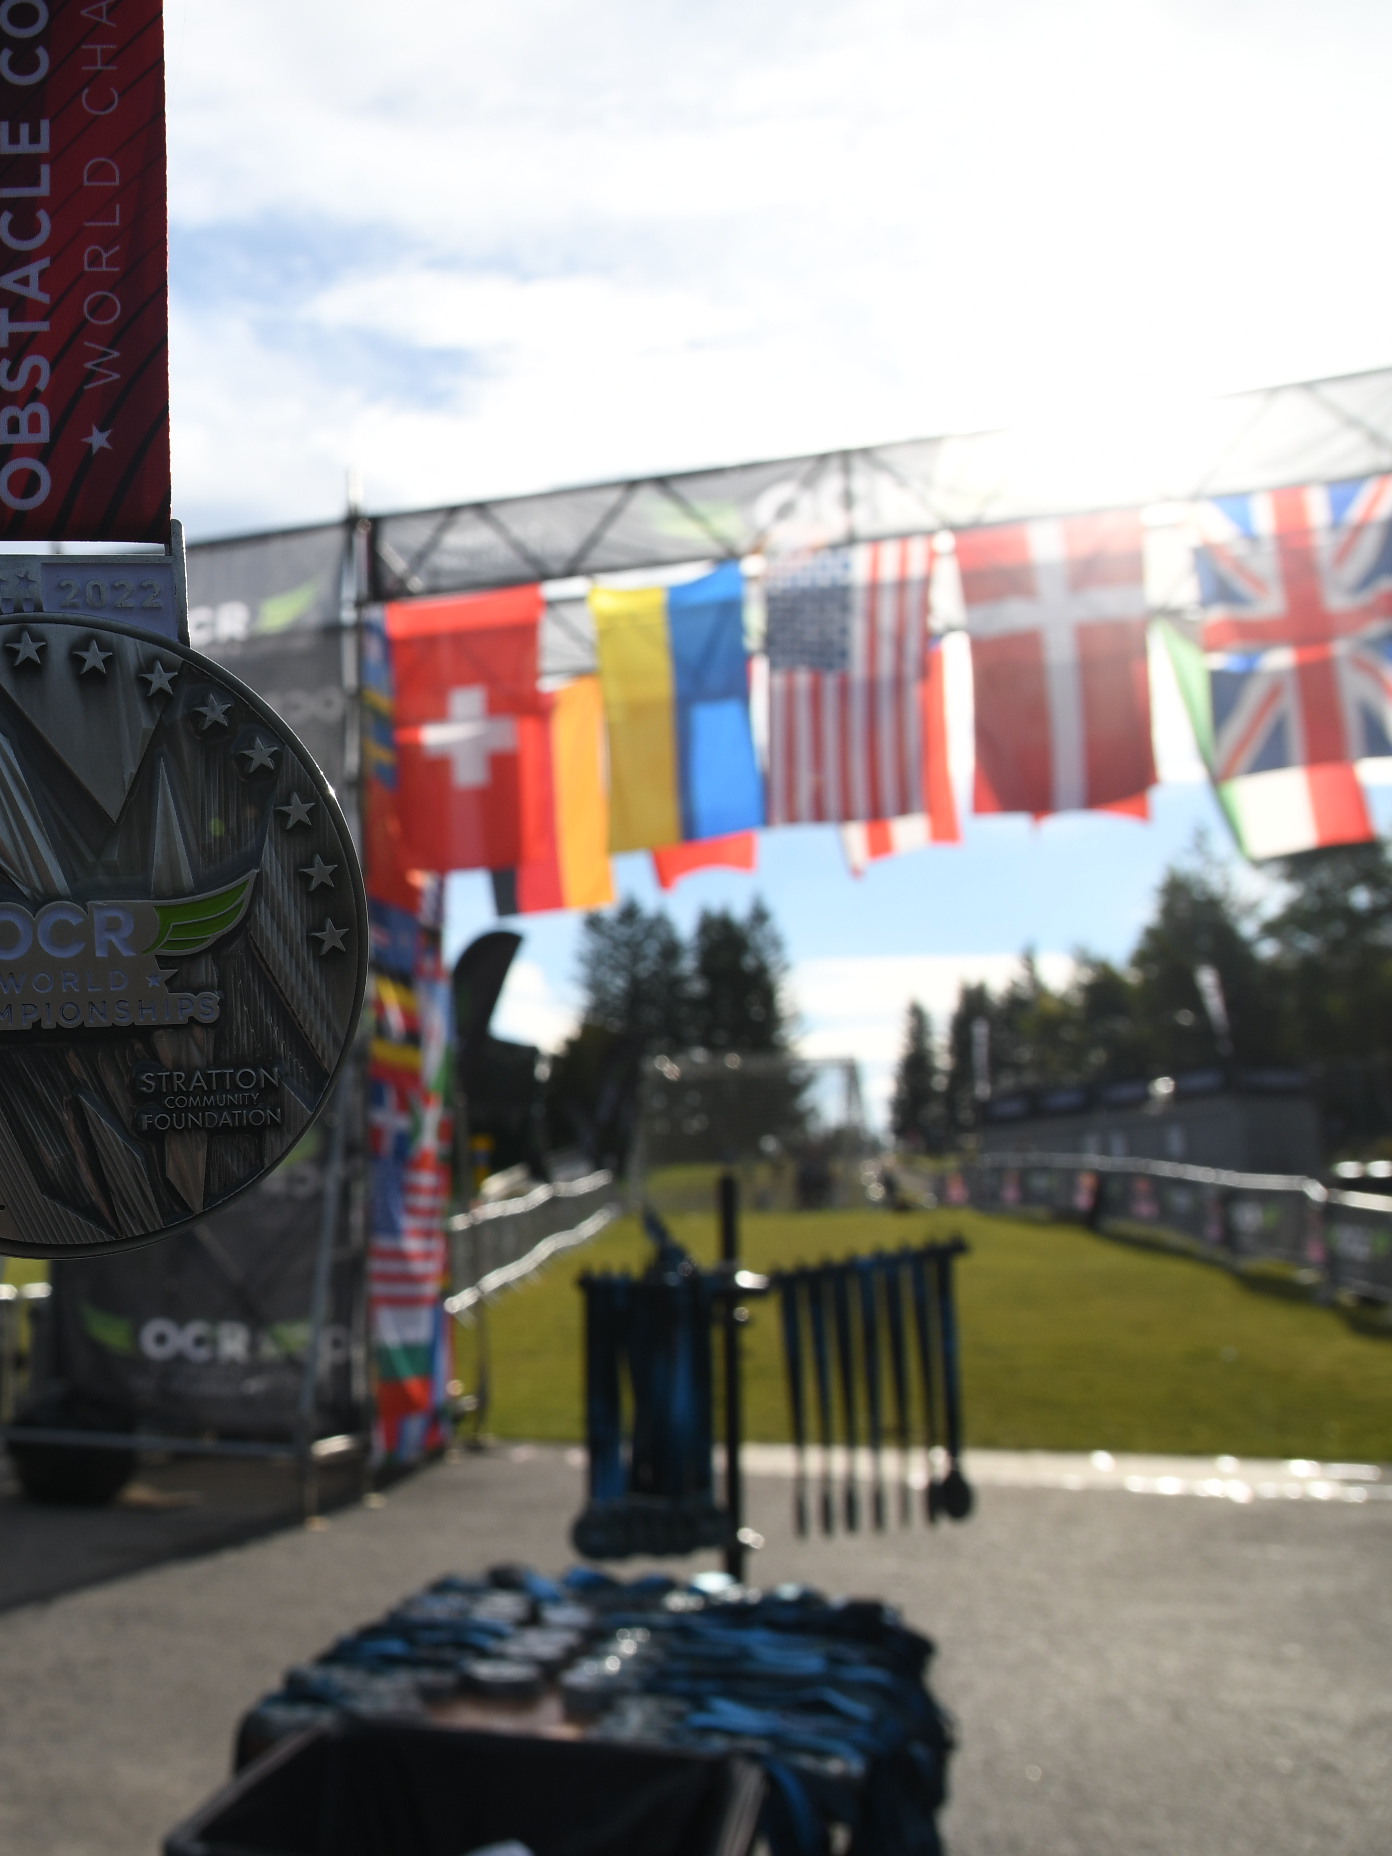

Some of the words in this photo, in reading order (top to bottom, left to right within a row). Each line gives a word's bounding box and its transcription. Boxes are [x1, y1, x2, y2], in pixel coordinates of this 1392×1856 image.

[82, 157, 121, 390] WORLD
[58, 578, 162, 609] 2022
[139, 1067, 280, 1093] STRATTON
[164, 1093, 259, 1109] COMMUNITY
[142, 1108, 282, 1131] FOUNDATION
[140, 1317, 250, 1364] OCR
